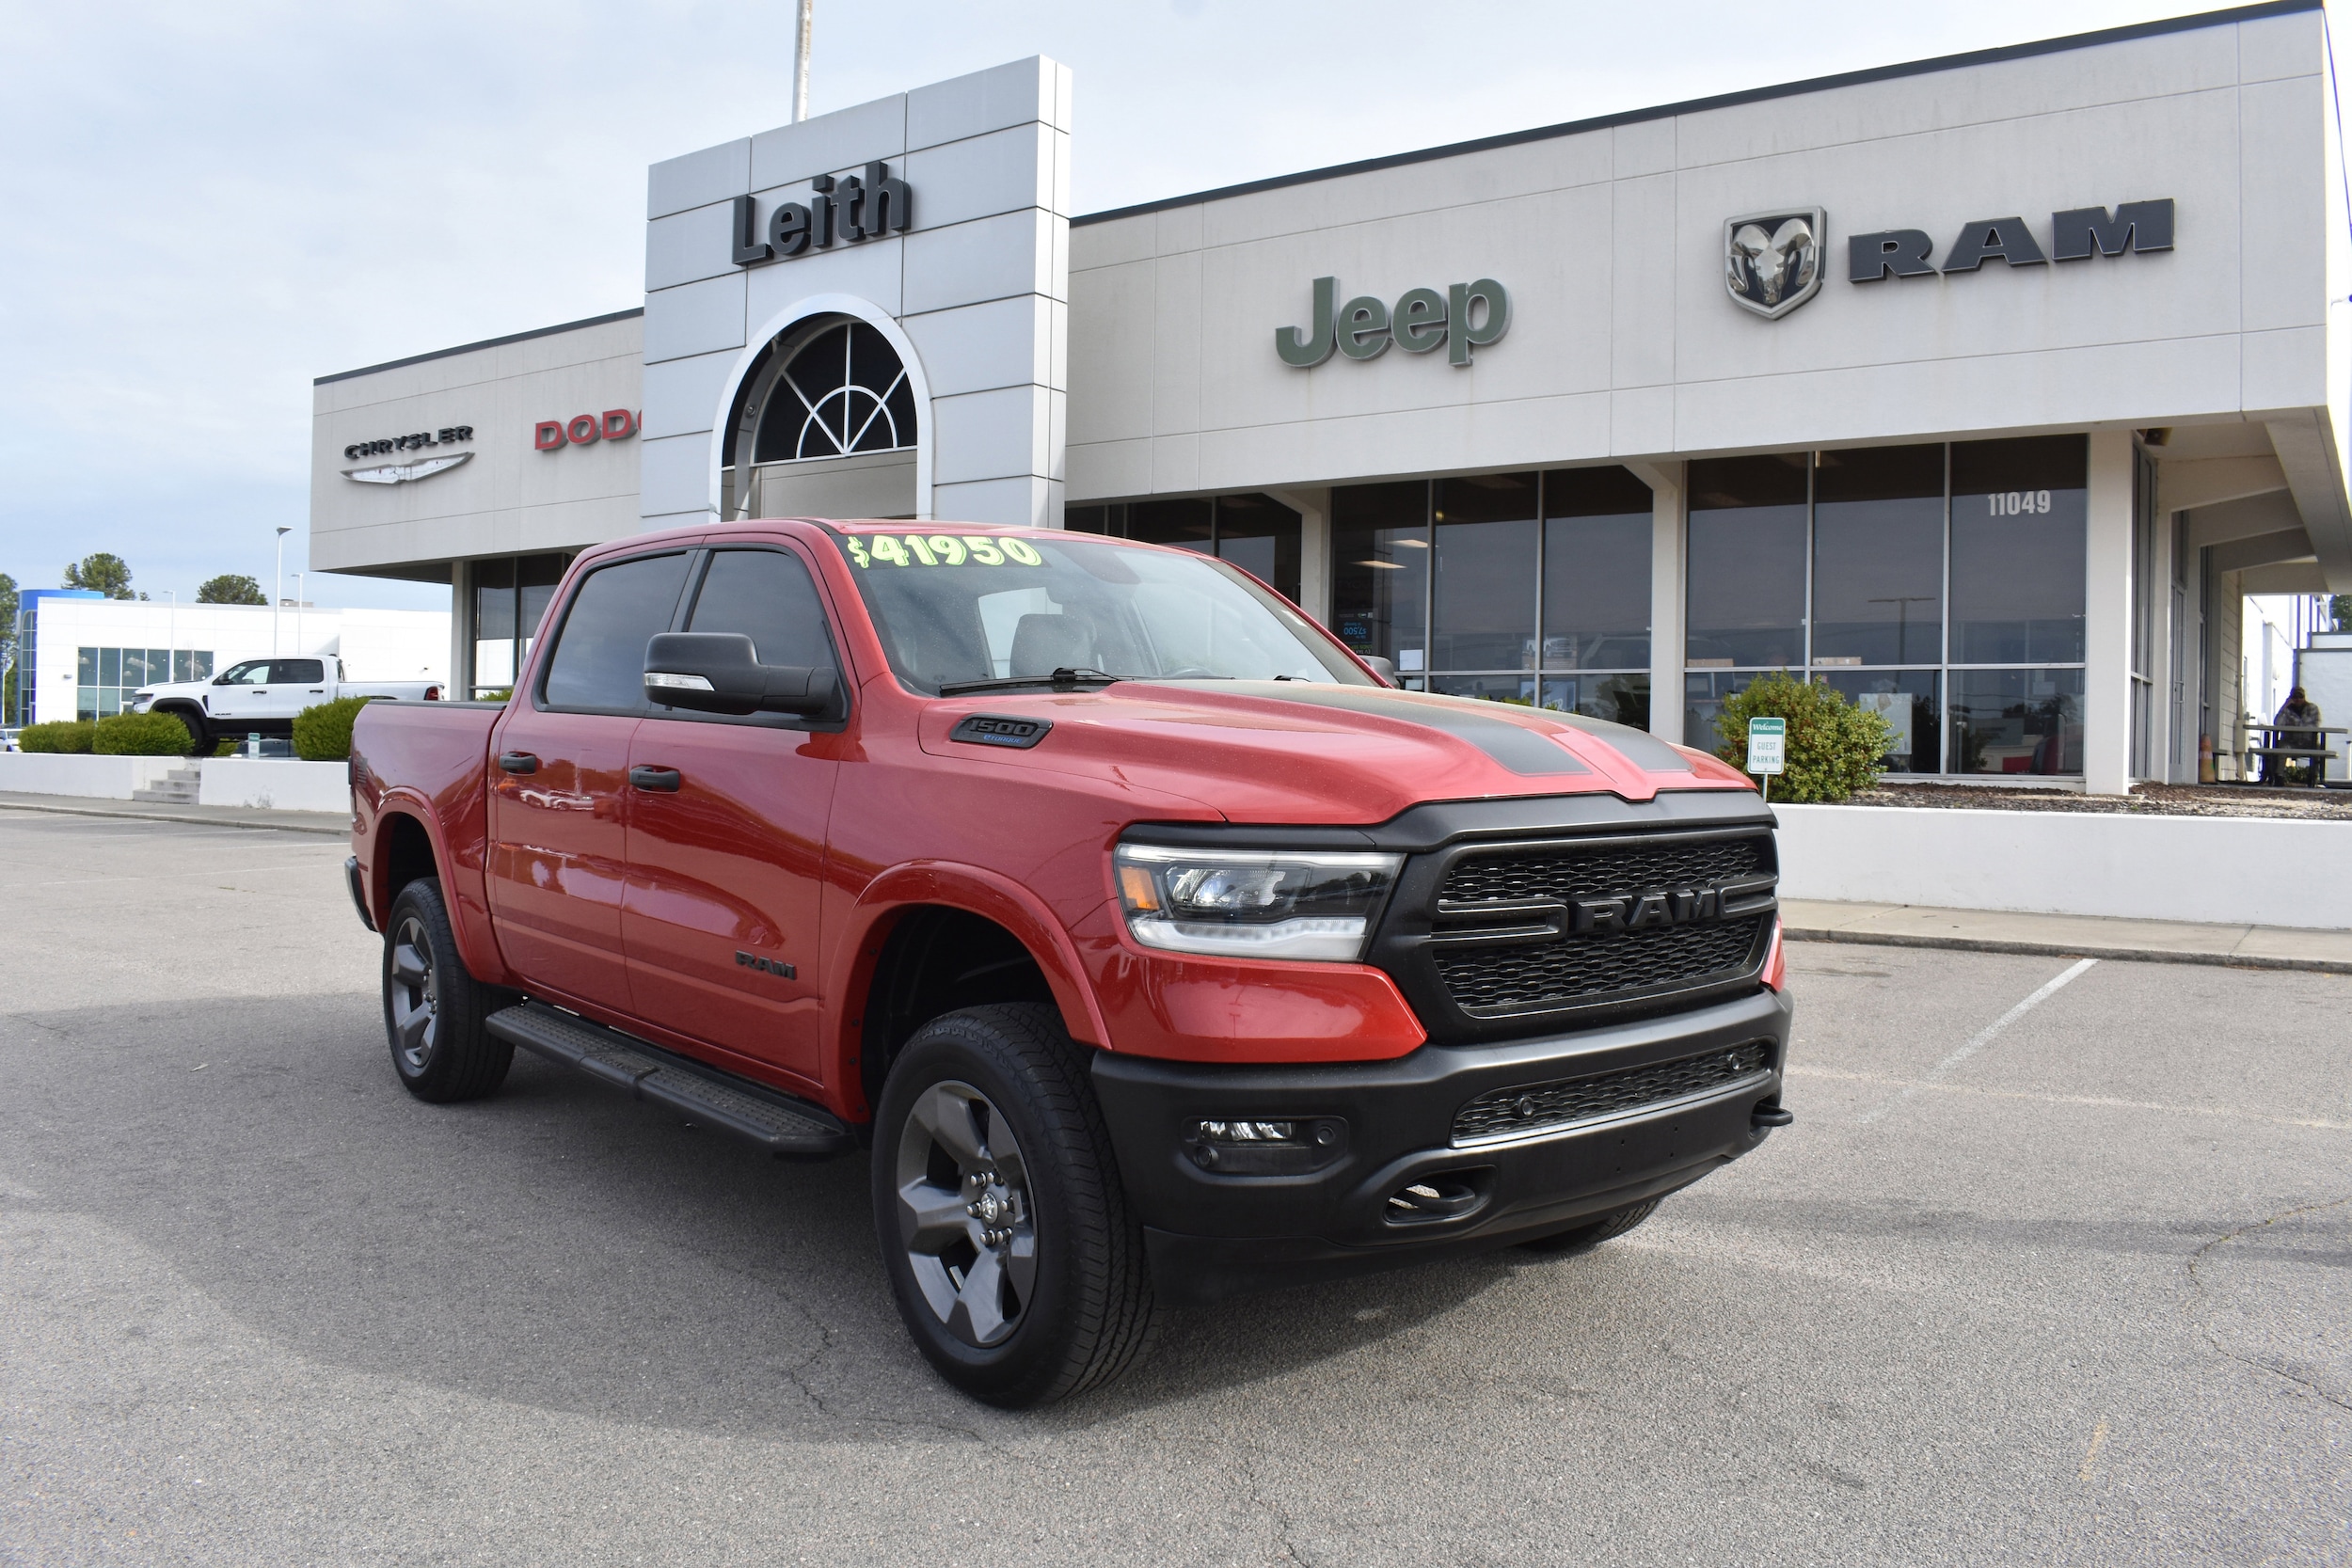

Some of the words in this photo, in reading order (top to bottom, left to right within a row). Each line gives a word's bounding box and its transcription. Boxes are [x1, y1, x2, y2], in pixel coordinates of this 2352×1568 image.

[732, 160, 913, 267] Leith
[1848, 198, 2174, 284] RAM
[1275, 276, 1513, 369] Jeep
[344, 425, 474, 460] CHRYSLER
[534, 407, 642, 451] DOD
[1988, 489, 2051, 516] 11049
[847, 534, 1042, 568] $41950
[969, 719, 1035, 736] 1500
[1752, 755, 1780, 764] PARKING
[1756, 741, 1777, 751] GUEST
[1575, 887, 1716, 932] RAM
[736, 950, 797, 980] RAM
